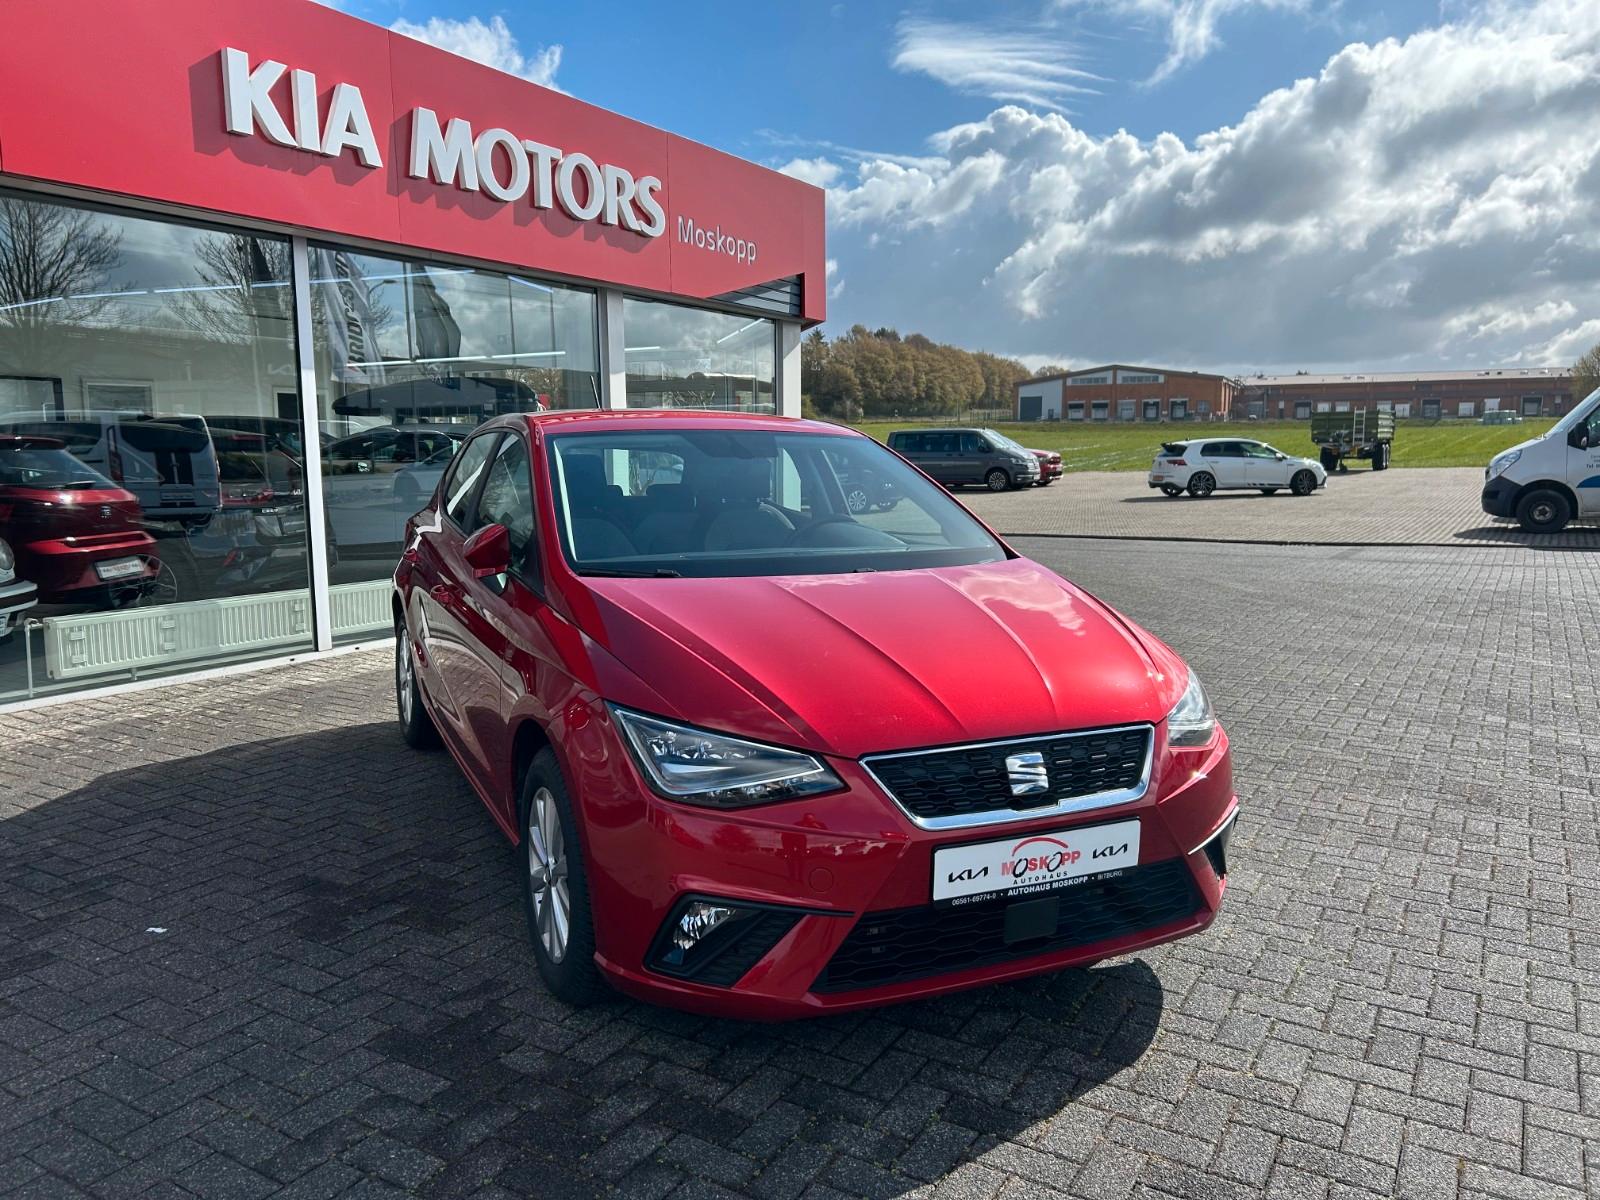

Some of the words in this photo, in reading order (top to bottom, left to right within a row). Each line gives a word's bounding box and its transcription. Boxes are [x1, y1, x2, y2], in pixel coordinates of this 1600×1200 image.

[221, 47, 383, 168] KIA
[409, 107, 665, 237] MOTORS
[678, 215, 756, 264] Moskopp
[1092, 843, 1128, 859] KIA
[948, 866, 989, 883] KIA
[1001, 851, 1081, 878] MOSKOPP
[1007, 882, 1051, 896] AUTOHAUS
[1052, 876, 1088, 889] MOSKOPP
[1013, 871, 1068, 885] AUTOHAUS
